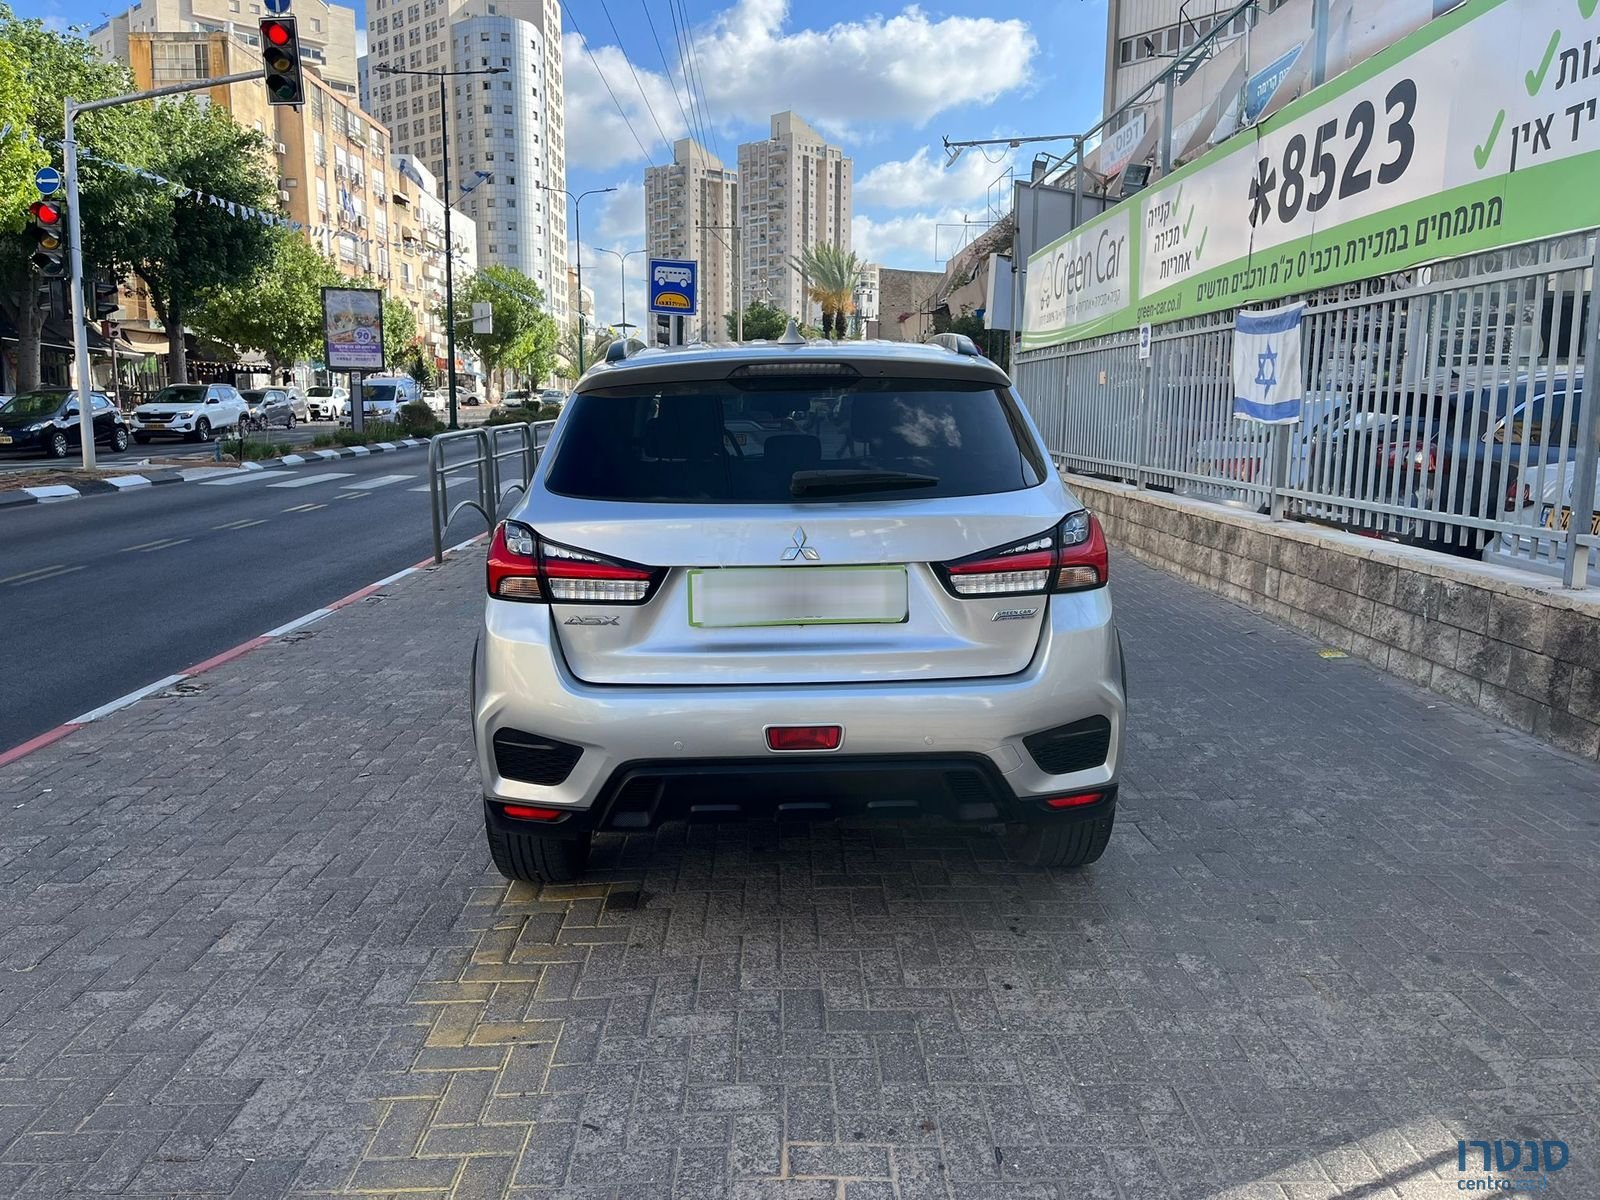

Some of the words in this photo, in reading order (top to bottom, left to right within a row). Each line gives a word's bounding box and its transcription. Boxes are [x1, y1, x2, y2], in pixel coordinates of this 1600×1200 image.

[1115, 121, 1140, 154] דפוס
[1509, 112, 1555, 173] אין
[1147, 201, 1171, 229] קנייה
[1414, 196, 1503, 247] מתמחים
[1154, 225, 1181, 253] מכירה
[1344, 224, 1410, 266] במכירת
[1054, 250, 1093, 300] Green
[1096, 229, 1125, 284] Car
[1159, 250, 1193, 280] אחריות
[1297, 250, 1306, 278] 0
[1310, 246, 1341, 275] רכבי
[1197, 276, 1229, 302] חדשים
[1231, 265, 1269, 292] ורכבים
[1136, 292, 1183, 324] green-car.co.il
[356, 331, 370, 340] 90
[563, 615, 620, 626] ASX
